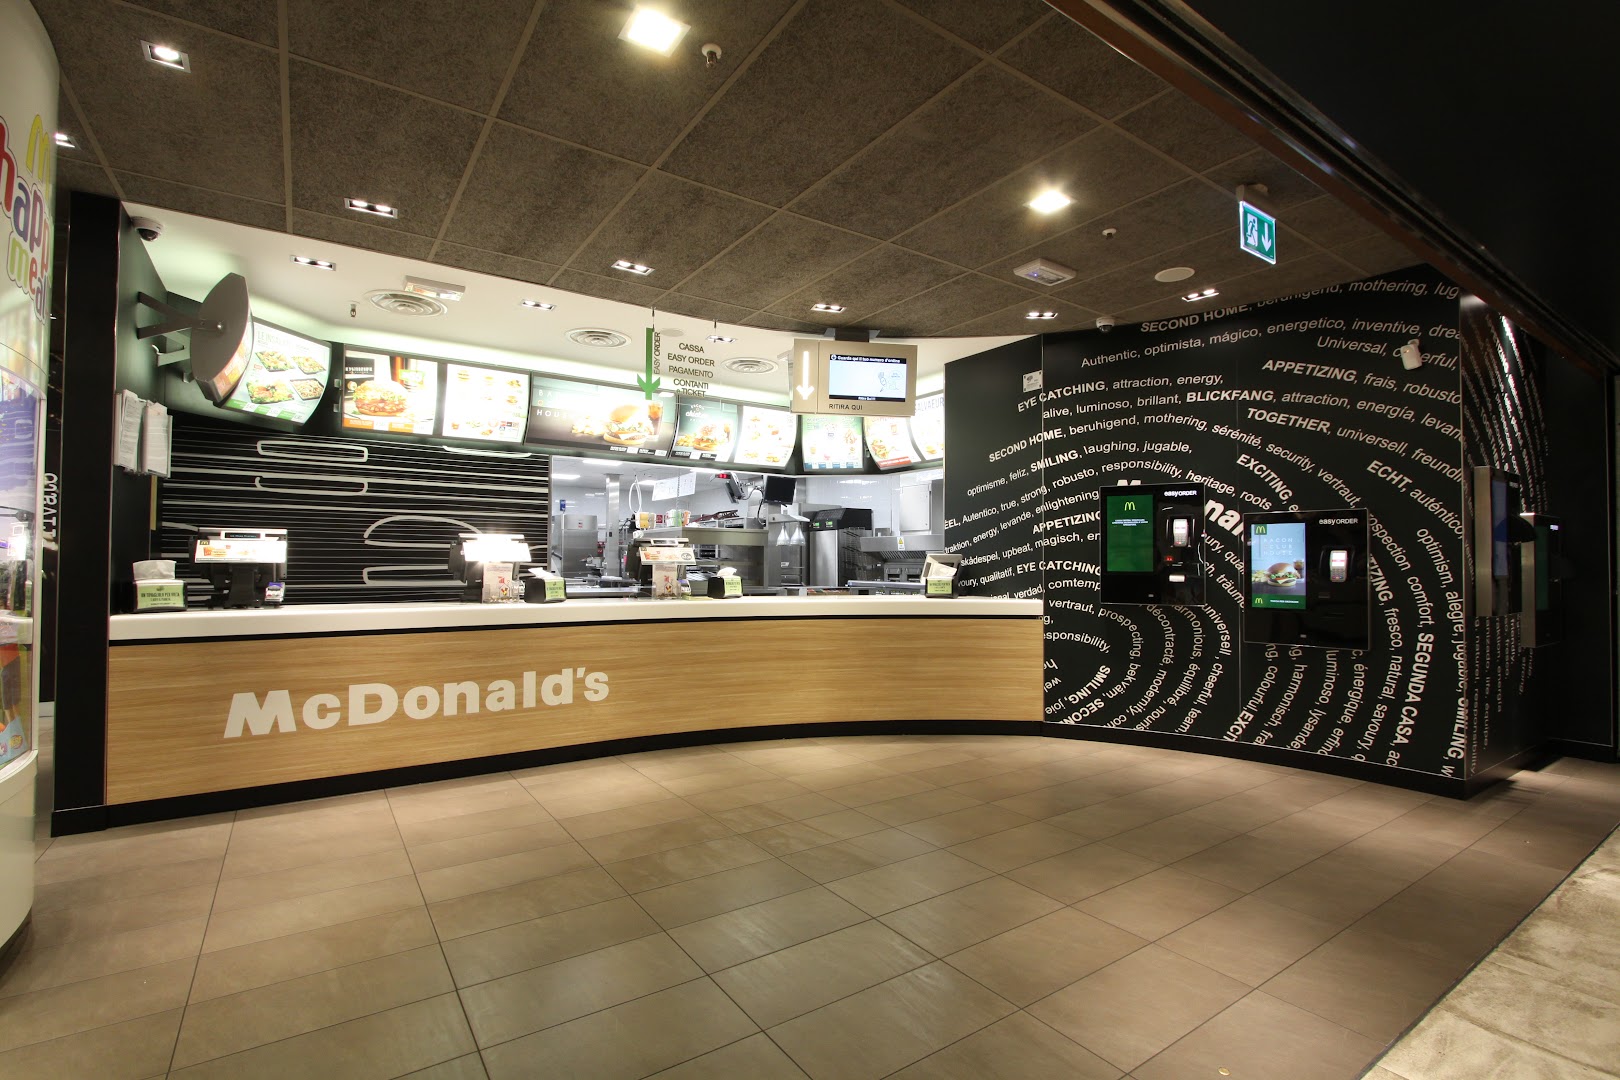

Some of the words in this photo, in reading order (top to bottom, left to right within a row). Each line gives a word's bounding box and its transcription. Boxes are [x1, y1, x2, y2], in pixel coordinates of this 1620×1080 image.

[1140, 313, 1200, 333] SECOND
[1348, 279, 1429, 297] mothering,
[653, 332, 661, 357] ORDER
[667, 352, 688, 364] EASY
[688, 356, 715, 367] ORDER
[678, 342, 705, 354] CASSA
[1081, 350, 1141, 369] Authentic,
[1144, 337, 1205, 357] optimista,
[1209, 325, 1262, 346] mágico,
[1266, 316, 1347, 335] energetico,
[1352, 317, 1422, 338] inventive,
[1317, 335, 1388, 358] Universal,
[653, 357, 661, 375] EASY
[668, 365, 714, 379] PAGAMENTO
[673, 378, 709, 390] CONTANTI
[1261, 359, 1358, 385] APPETIZING,
[1363, 371, 1398, 391] frais,
[681, 388, 707, 398] TICKET
[1017, 396, 1038, 412] EYE
[1039, 380, 1109, 402] CATCHING,
[1112, 375, 1173, 390] attraction,
[1177, 373, 1224, 389] energy,
[1043, 405, 1073, 419] alive,
[1076, 398, 1133, 415] luminoso,
[1137, 393, 1182, 408] brillant,
[1186, 390, 1277, 403] BLICKFANG,
[1281, 391, 1351, 410] attraction,
[1356, 398, 1416, 423] energía,
[1246, 407, 1332, 436] TOGETHER,
[1336, 426, 1409, 458] universell,
[967, 474, 1009, 498] optimisme,
[1009, 467, 1030, 481] feliz,
[1030, 449, 1083, 473] SMILING,
[1083, 440, 1141, 455] laughing,
[1142, 440, 1193, 455] jugable,
[988, 439, 1027, 462] SECOND
[1028, 427, 1067, 447] HOME,
[1069, 414, 1140, 436] beruhigend,
[1143, 413, 1208, 432] mothering,
[1212, 424, 1263, 450] sérénité,
[1265, 442, 1316, 474] security,
[1316, 468, 1362, 510] vertraut,
[1236, 453, 1293, 505] EXCITING,
[1366, 459, 1413, 493] ECHT,
[962, 506, 1000, 525] Autentico,
[1000, 499, 1020, 512] true,
[1020, 484, 1051, 504] strong,
[1052, 467, 1100, 489] robusto,
[1101, 459, 1183, 479] responsibility,
[1185, 469, 1236, 498] heritage,
[1239, 490, 1273, 511] roots
[960, 550, 1001, 567] skådespel,
[1002, 542, 1034, 559] upbeat,
[1034, 531, 1084, 550] magisch,
[972, 526, 1000, 544] energy,
[999, 511, 1035, 531] levande,
[980, 567, 1015, 586] qualitatif,
[1016, 561, 1037, 575] EYE
[1416, 528, 1455, 590] optimism,
[1445, 591, 1465, 637] alegre,
[1048, 599, 1096, 615] vertraut,
[1407, 576, 1436, 629] comfort,
[1097, 607, 1145, 660] prospecting,
[1146, 604, 1177, 666] décontracté,
[1383, 607, 1403, 652] fresco,
[1064, 664, 1112, 706] SMILING,
[1102, 662, 1142, 699] bekväm,
[1162, 662, 1201, 706] équilibré,
[1193, 662, 1224, 706] cheerful,
[1243, 665, 1278, 712] colourful,
[1314, 649, 1340, 706] luminoso,
[1377, 654, 1403, 700] natural,
[1404, 632, 1435, 703] SEGUNDA
[223, 667, 609, 739] McDonald's
[1126, 669, 1168, 716] modernity,
[1263, 664, 1308, 728] harmonisch,
[1336, 662, 1369, 725] énergique,
[1174, 707, 1203, 733] team,
[1286, 708, 1327, 750] lysande,
[1356, 702, 1388, 751] savoury,
